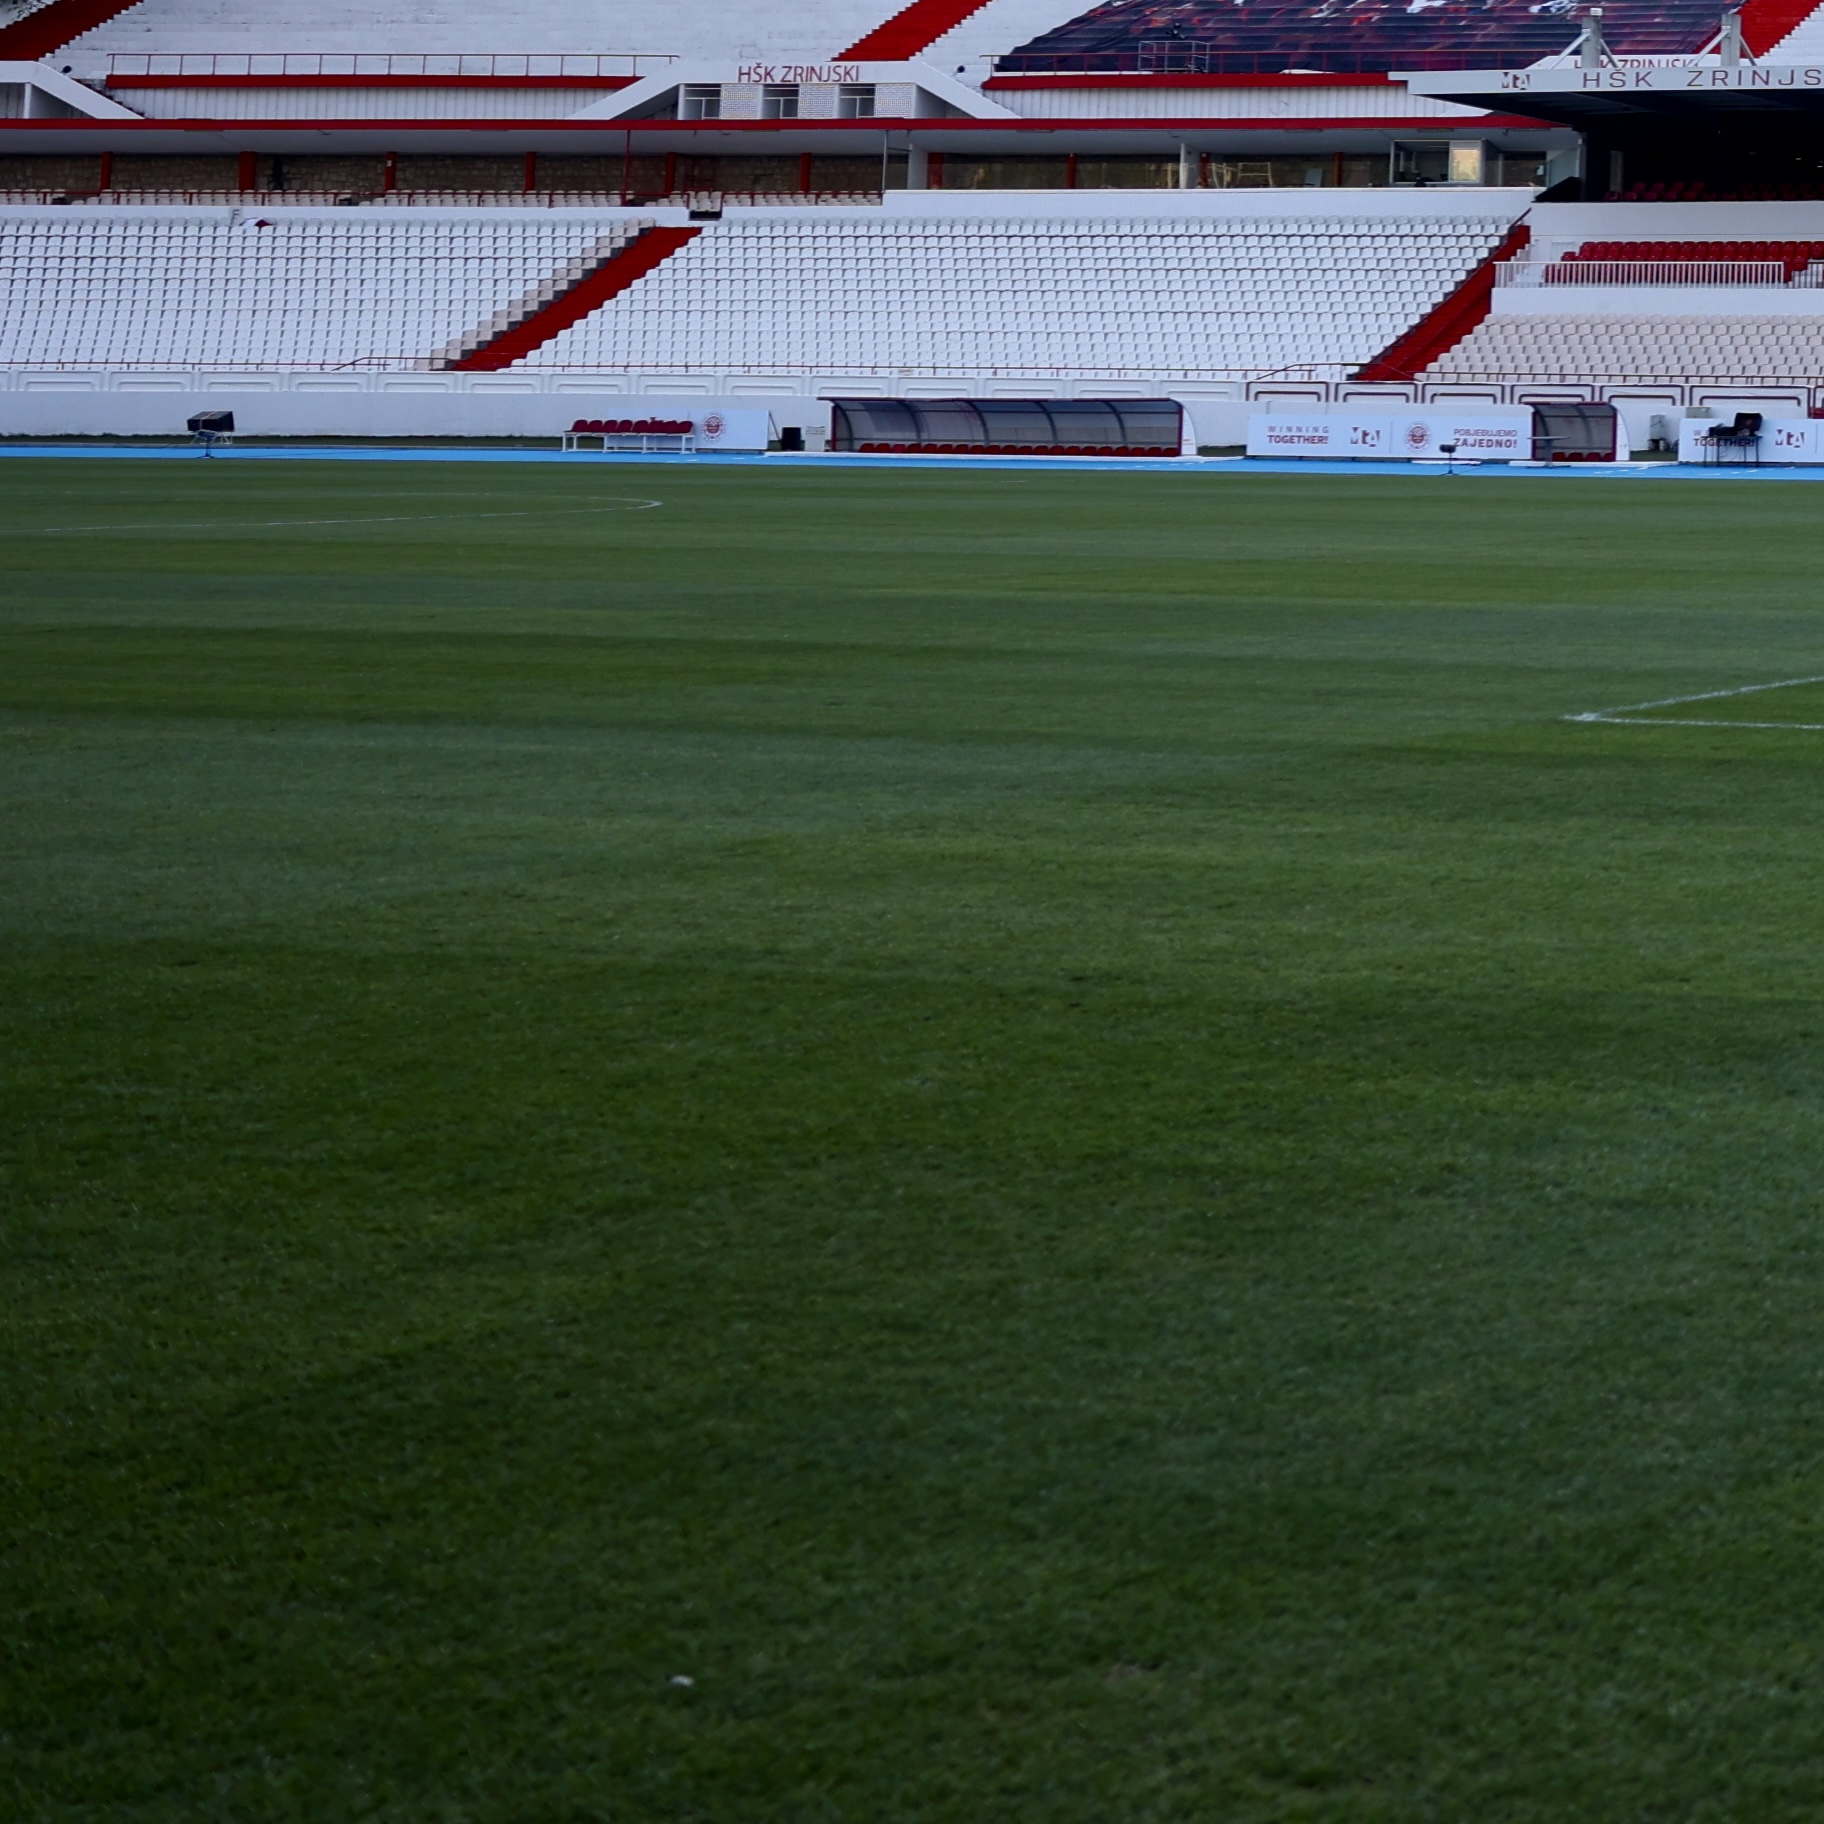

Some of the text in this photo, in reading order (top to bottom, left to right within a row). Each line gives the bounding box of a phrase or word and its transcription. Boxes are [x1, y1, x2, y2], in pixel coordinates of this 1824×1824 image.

[738, 62, 860, 83] HŠK ZRINJSKI
[1582, 68, 1653, 88] HŠK
[1267, 434, 1328, 445] TOGETHER!
[1453, 438, 1517, 449] ZAJEDNO!
